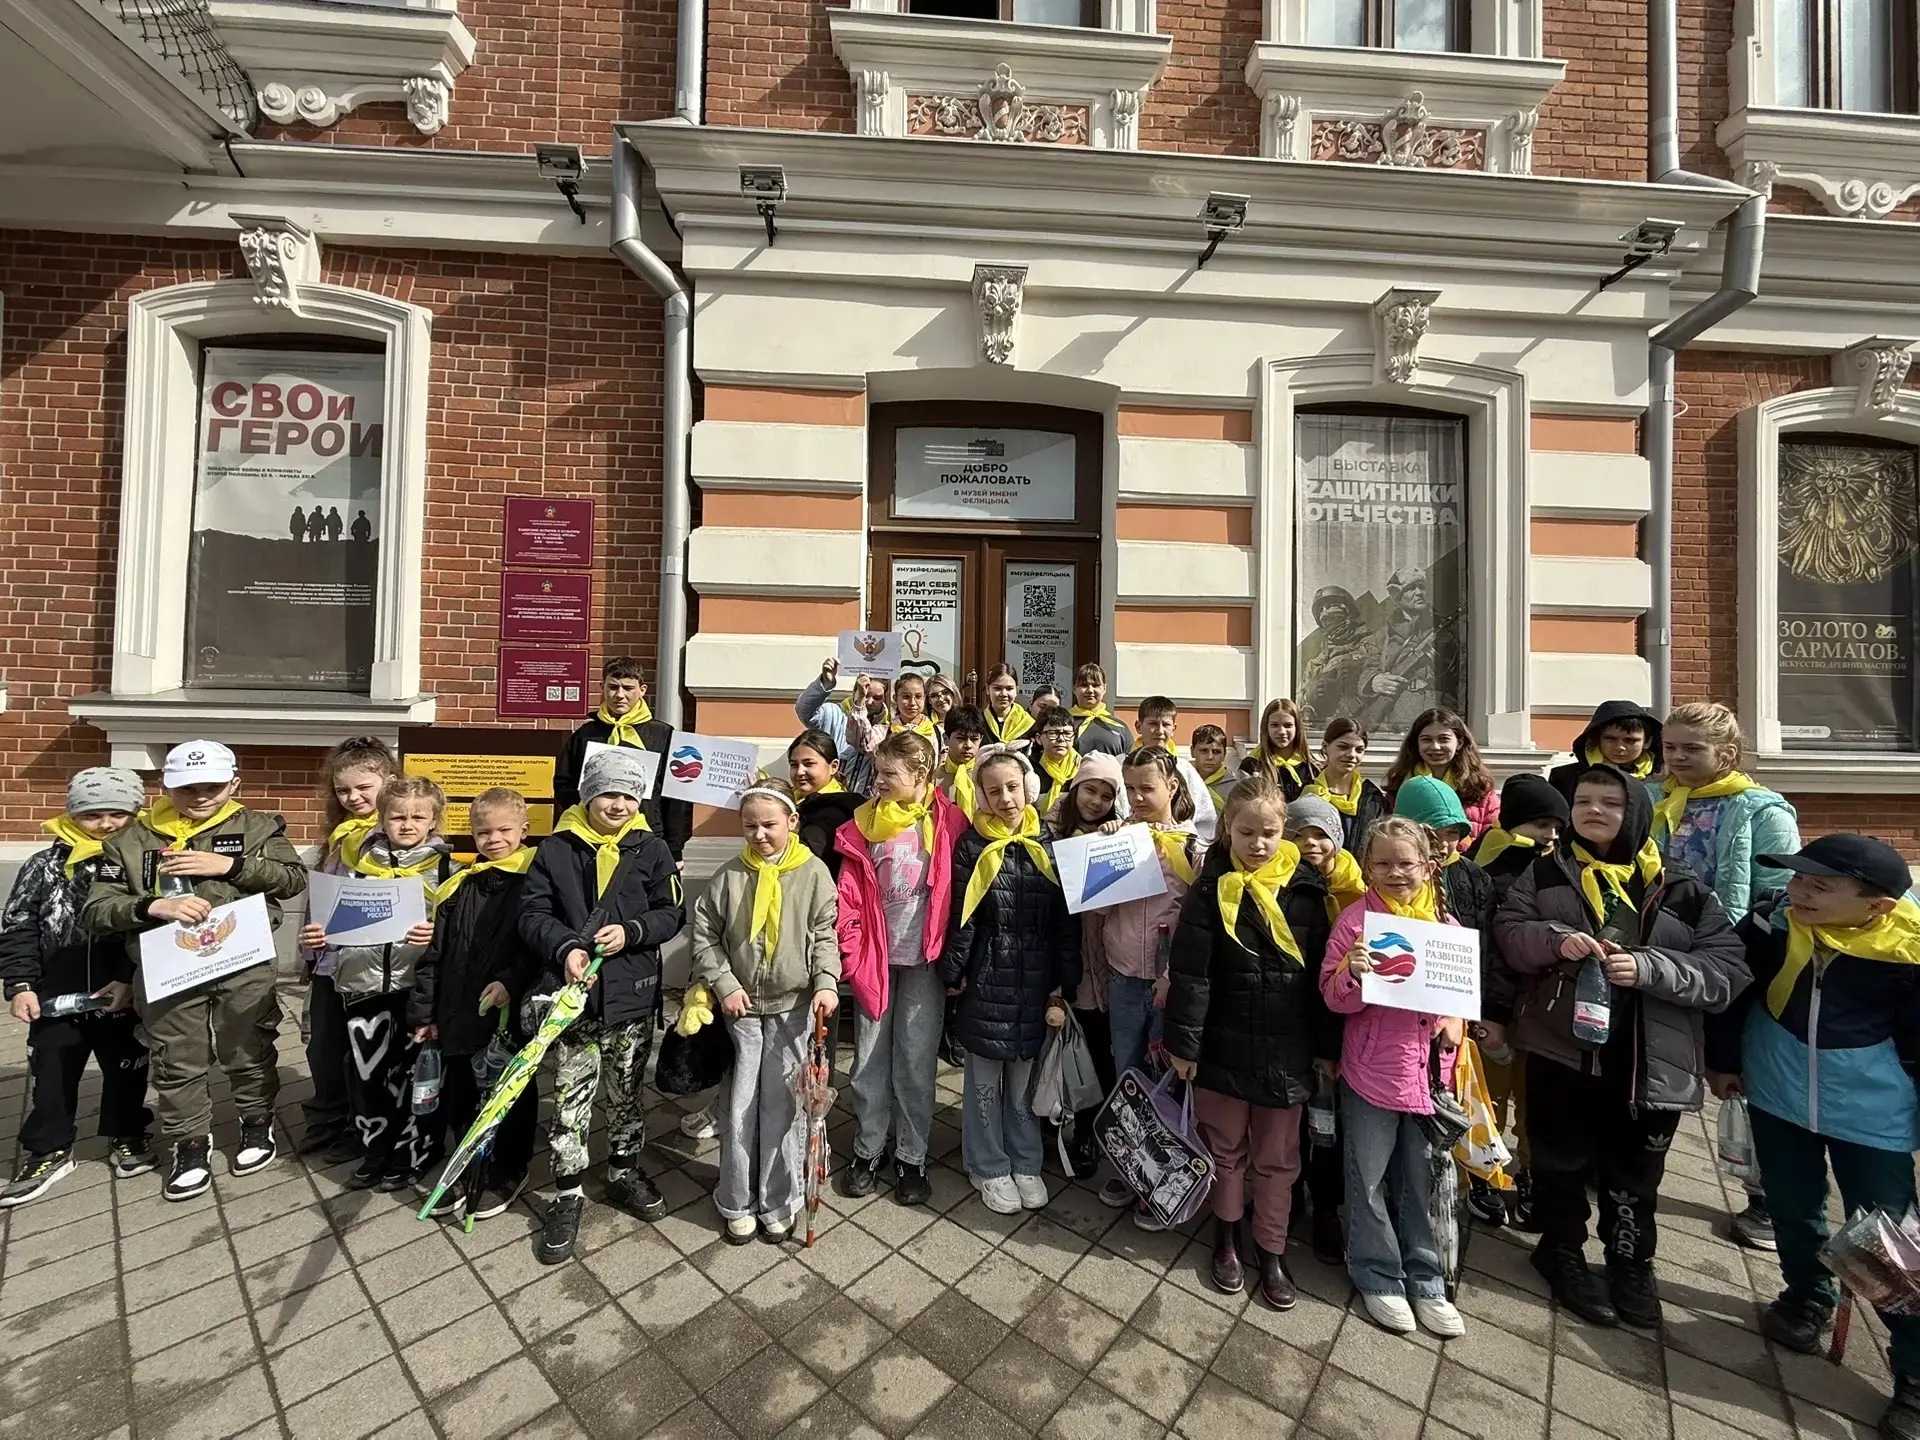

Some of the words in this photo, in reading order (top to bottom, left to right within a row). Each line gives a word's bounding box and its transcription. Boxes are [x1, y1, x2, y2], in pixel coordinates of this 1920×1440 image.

[211, 381, 355, 421] СВОи
[206, 418, 384, 458] ГЕРОИ
[963, 463, 1008, 474] ДОБРО
[1333, 459, 1422, 474] ВЫСТАВКА
[940, 474, 1031, 485] ПОЖАЛОВАТЬ
[961, 488, 988, 497] МУЗЕЙ
[962, 497, 1010, 505] ФЕЛИЦЫНА
[1305, 502, 1457, 525] ОТЕЧЕСТВА
[1010, 570, 1070, 578] #МУЗЕЙФЕЛИЦЫНА
[1779, 620, 1867, 639] ЗОЛОТО
[1779, 661, 1826, 669] ИСКУССТВО
[1864, 662, 1907, 670] МАСТЕРОВ
[711, 752, 751, 763] АГЕНТСТВО
[710, 759, 749, 771] РАЗВИТИЯ
[708, 774, 746, 786] ТУРИЗМА
[213, 845, 243, 853] NIGHTCLUB
[1425, 939, 1473, 954] АГЕНТСТВО
[1425, 949, 1473, 965] РАЗВИТИЯ
[160, 964, 213, 987] МИНИСТЕРСТВО
[214, 948, 261, 967] ПРОСВЕЩЕНИЯ
[171, 968, 215, 989] РОССИЙСКОЙ
[215, 956, 254, 972] ФЕДЕРАЦИИ
[1425, 960, 1473, 974] ВНУТРЕННЕГО
[1425, 969, 1473, 986] ТУРИЗМА
